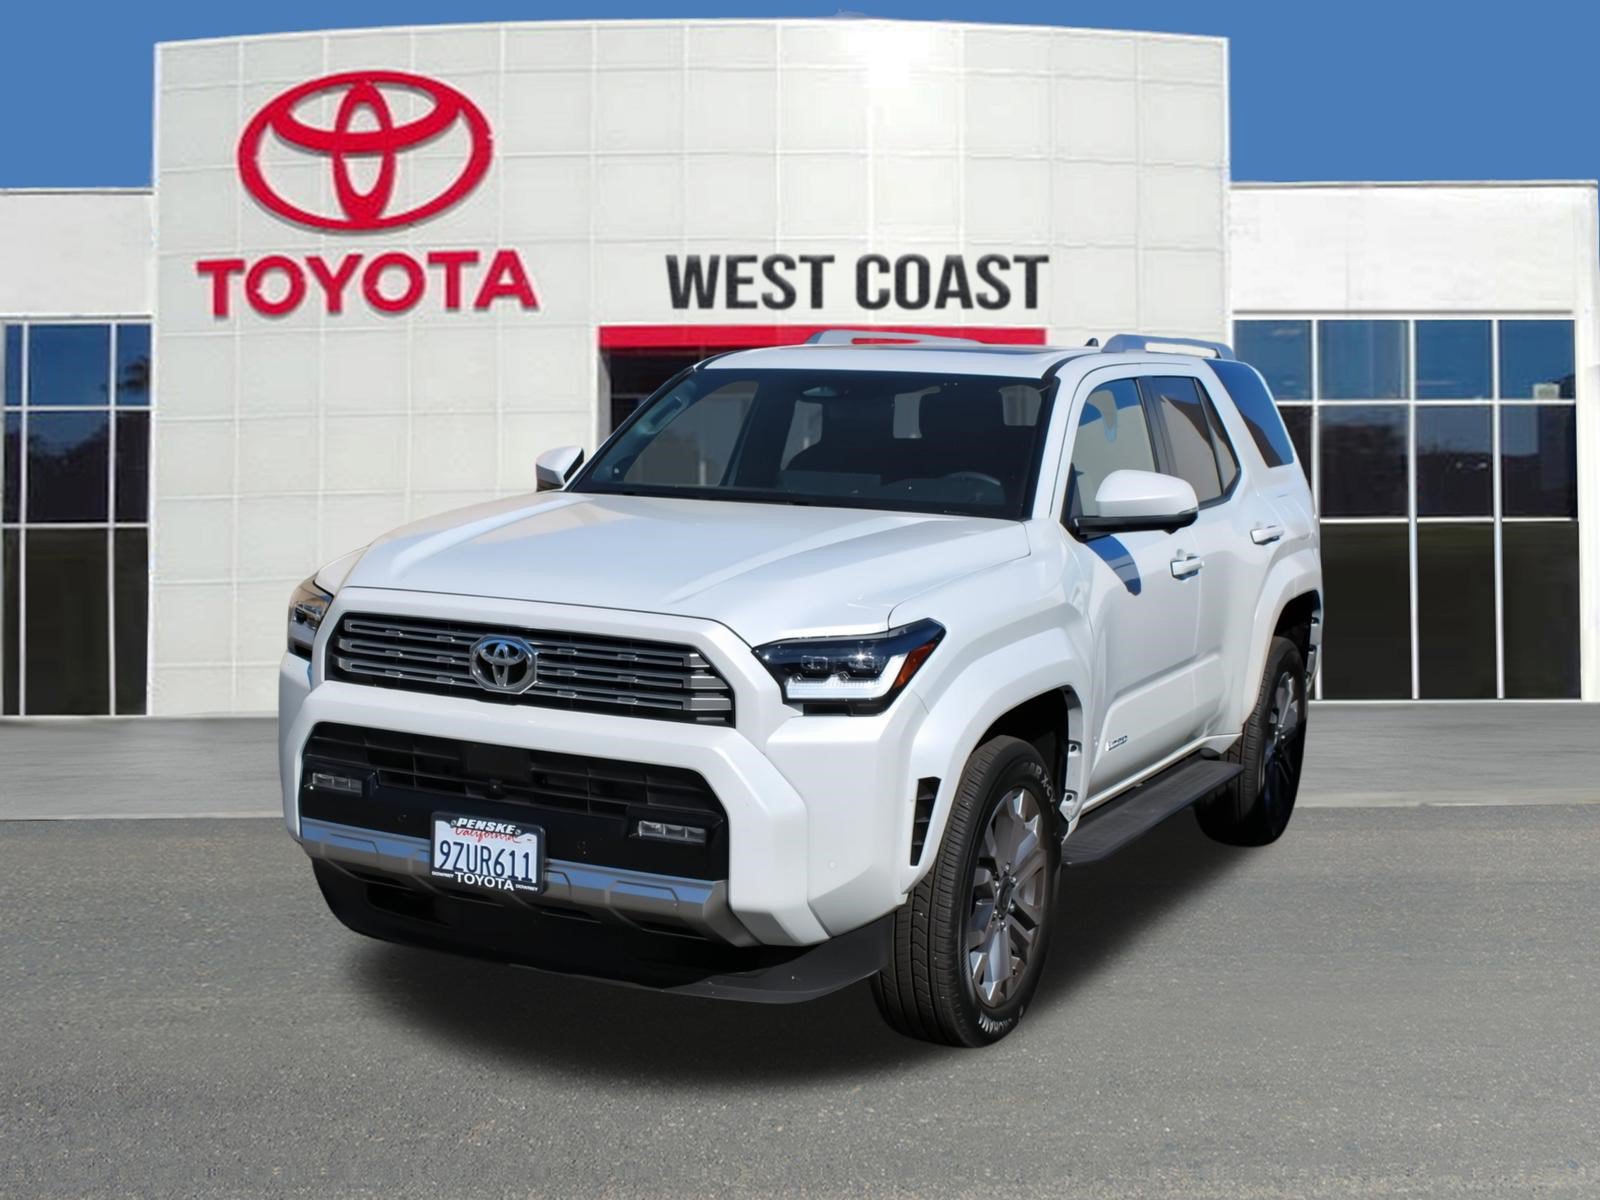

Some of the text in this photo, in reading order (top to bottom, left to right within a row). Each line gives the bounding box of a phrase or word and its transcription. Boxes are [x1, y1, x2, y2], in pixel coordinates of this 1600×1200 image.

[197, 249, 539, 318] TOYOTA
[665, 253, 1050, 310] WEST COAST
[456, 817, 517, 835] PENSKE
[440, 840, 533, 883] 9ZUR611
[454, 872, 515, 891] TOYOTA
